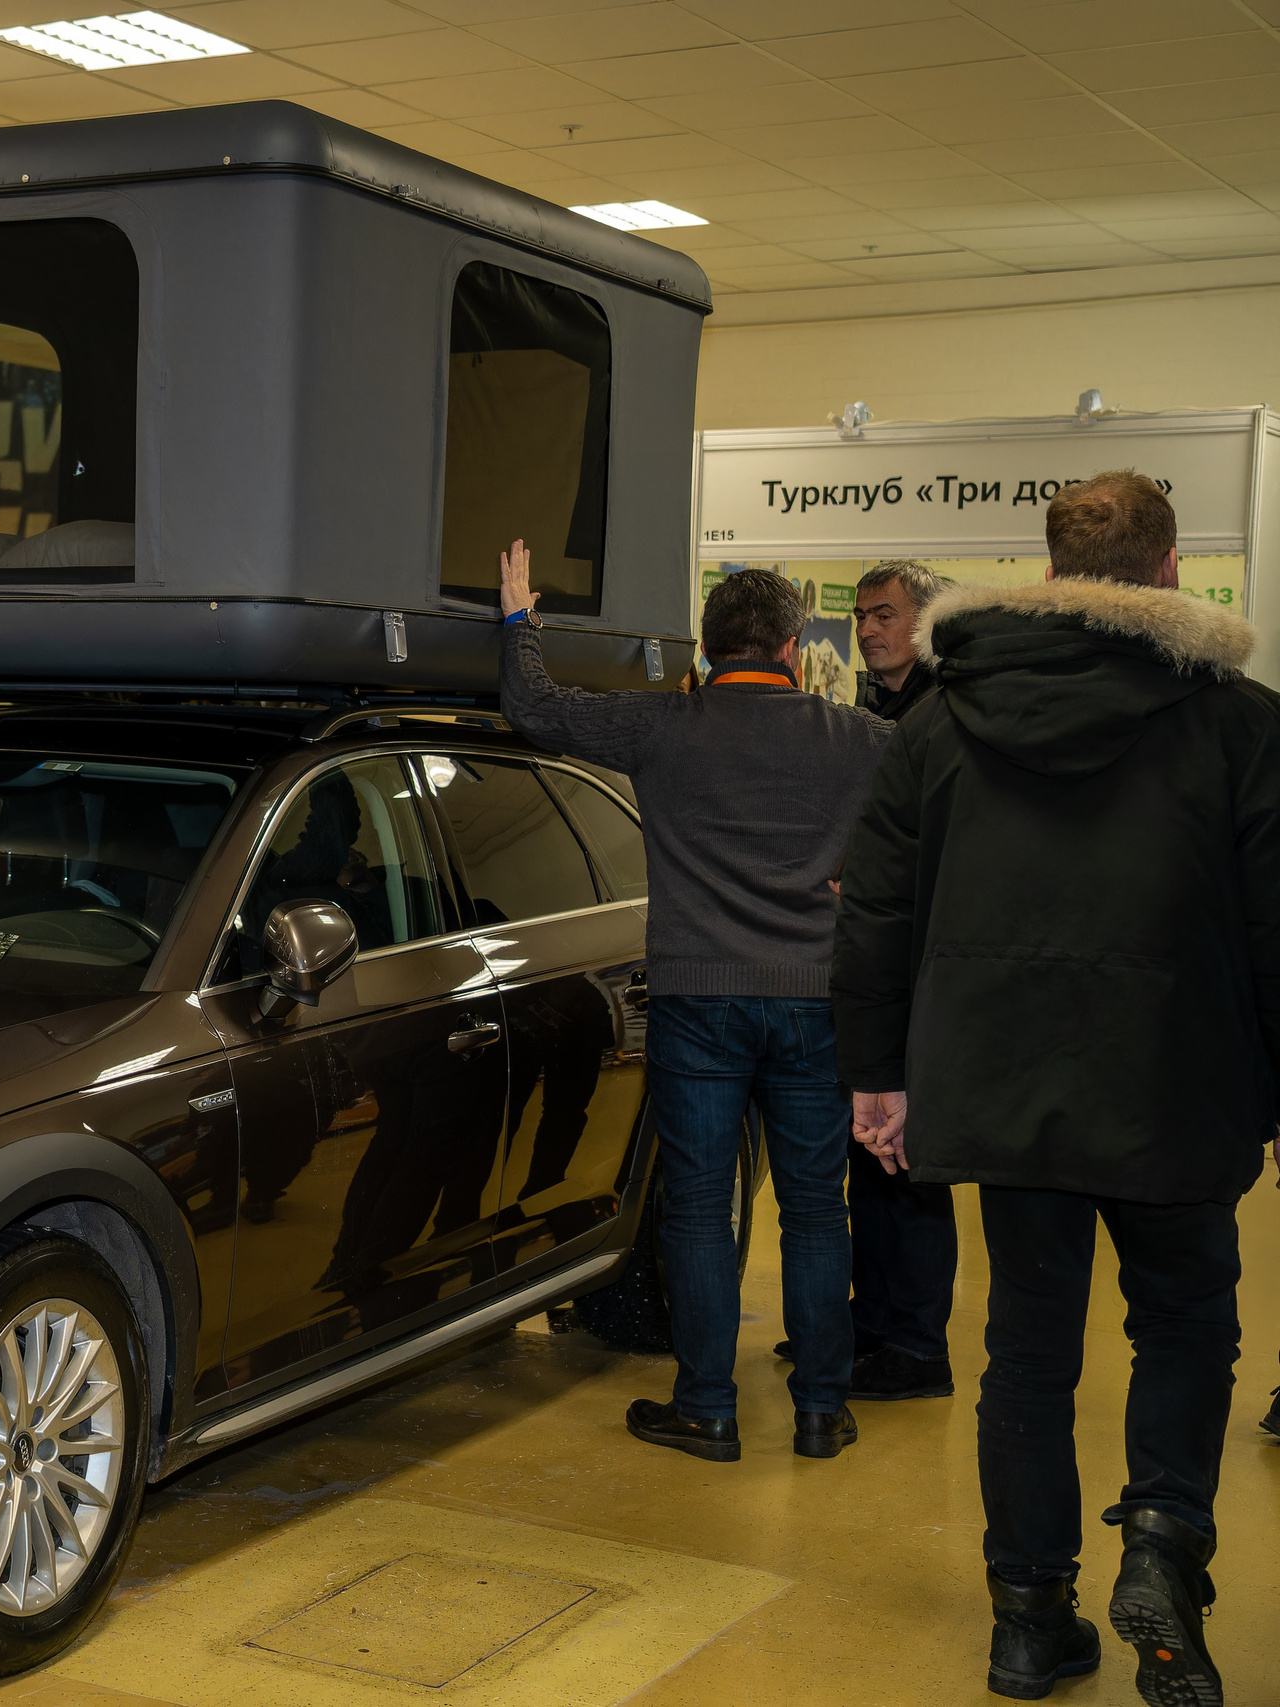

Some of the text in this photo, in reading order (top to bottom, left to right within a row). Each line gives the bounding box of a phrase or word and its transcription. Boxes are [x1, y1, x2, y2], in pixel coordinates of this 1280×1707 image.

[761, 476, 903, 513] Турклуб
[915, 475, 1000, 509] «Три
[704, 530, 734, 541] 1E15
